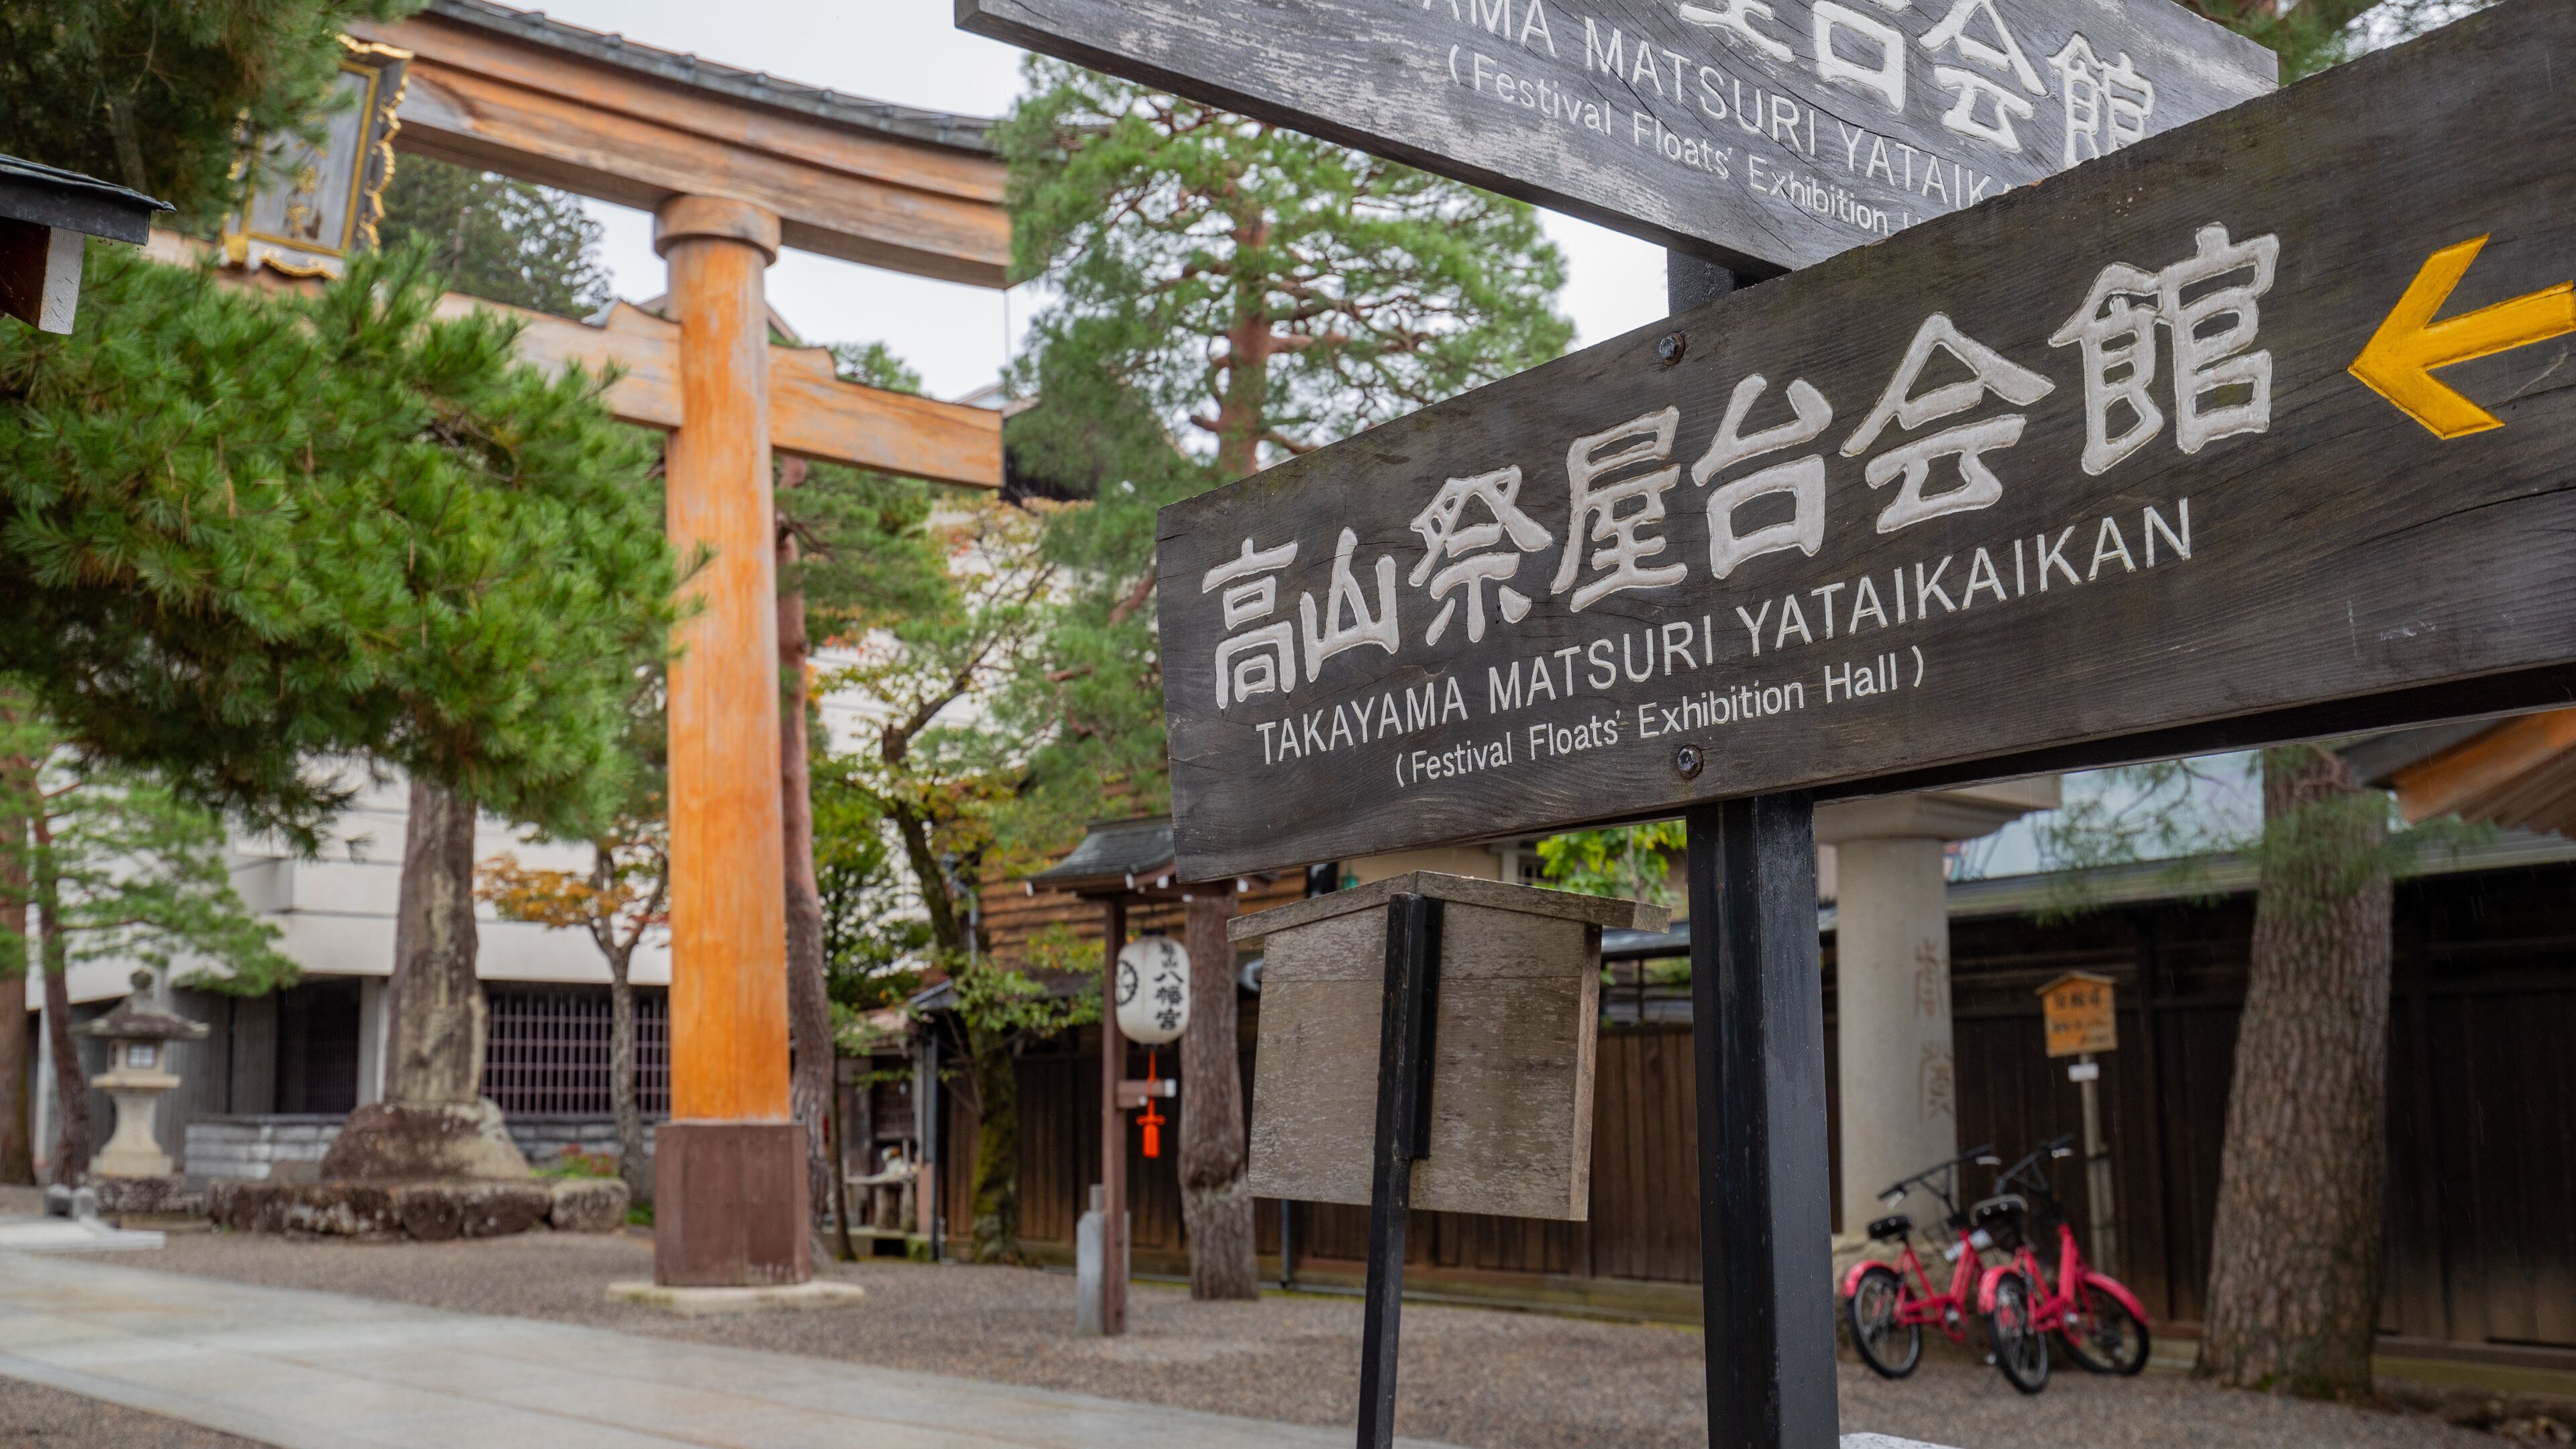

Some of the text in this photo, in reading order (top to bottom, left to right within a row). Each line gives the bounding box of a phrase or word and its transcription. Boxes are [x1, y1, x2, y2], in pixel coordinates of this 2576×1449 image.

[1584, 15, 1817, 156] MATSURI
[1837, 121, 2012, 211] YATAIK
[1633, 111, 1732, 180] Floats'
[1748, 155, 1890, 237] Exhibition
[1201, 221, 2281, 710] 高山祭屋台会館
[1256, 497, 2192, 765] TAKAYAMA MATSURI YATAIKAIKAN
[1395, 732, 1513, 788] (Festival
[1529, 710, 1620, 760] Floats'
[1639, 683, 1805, 739] Exhibition
